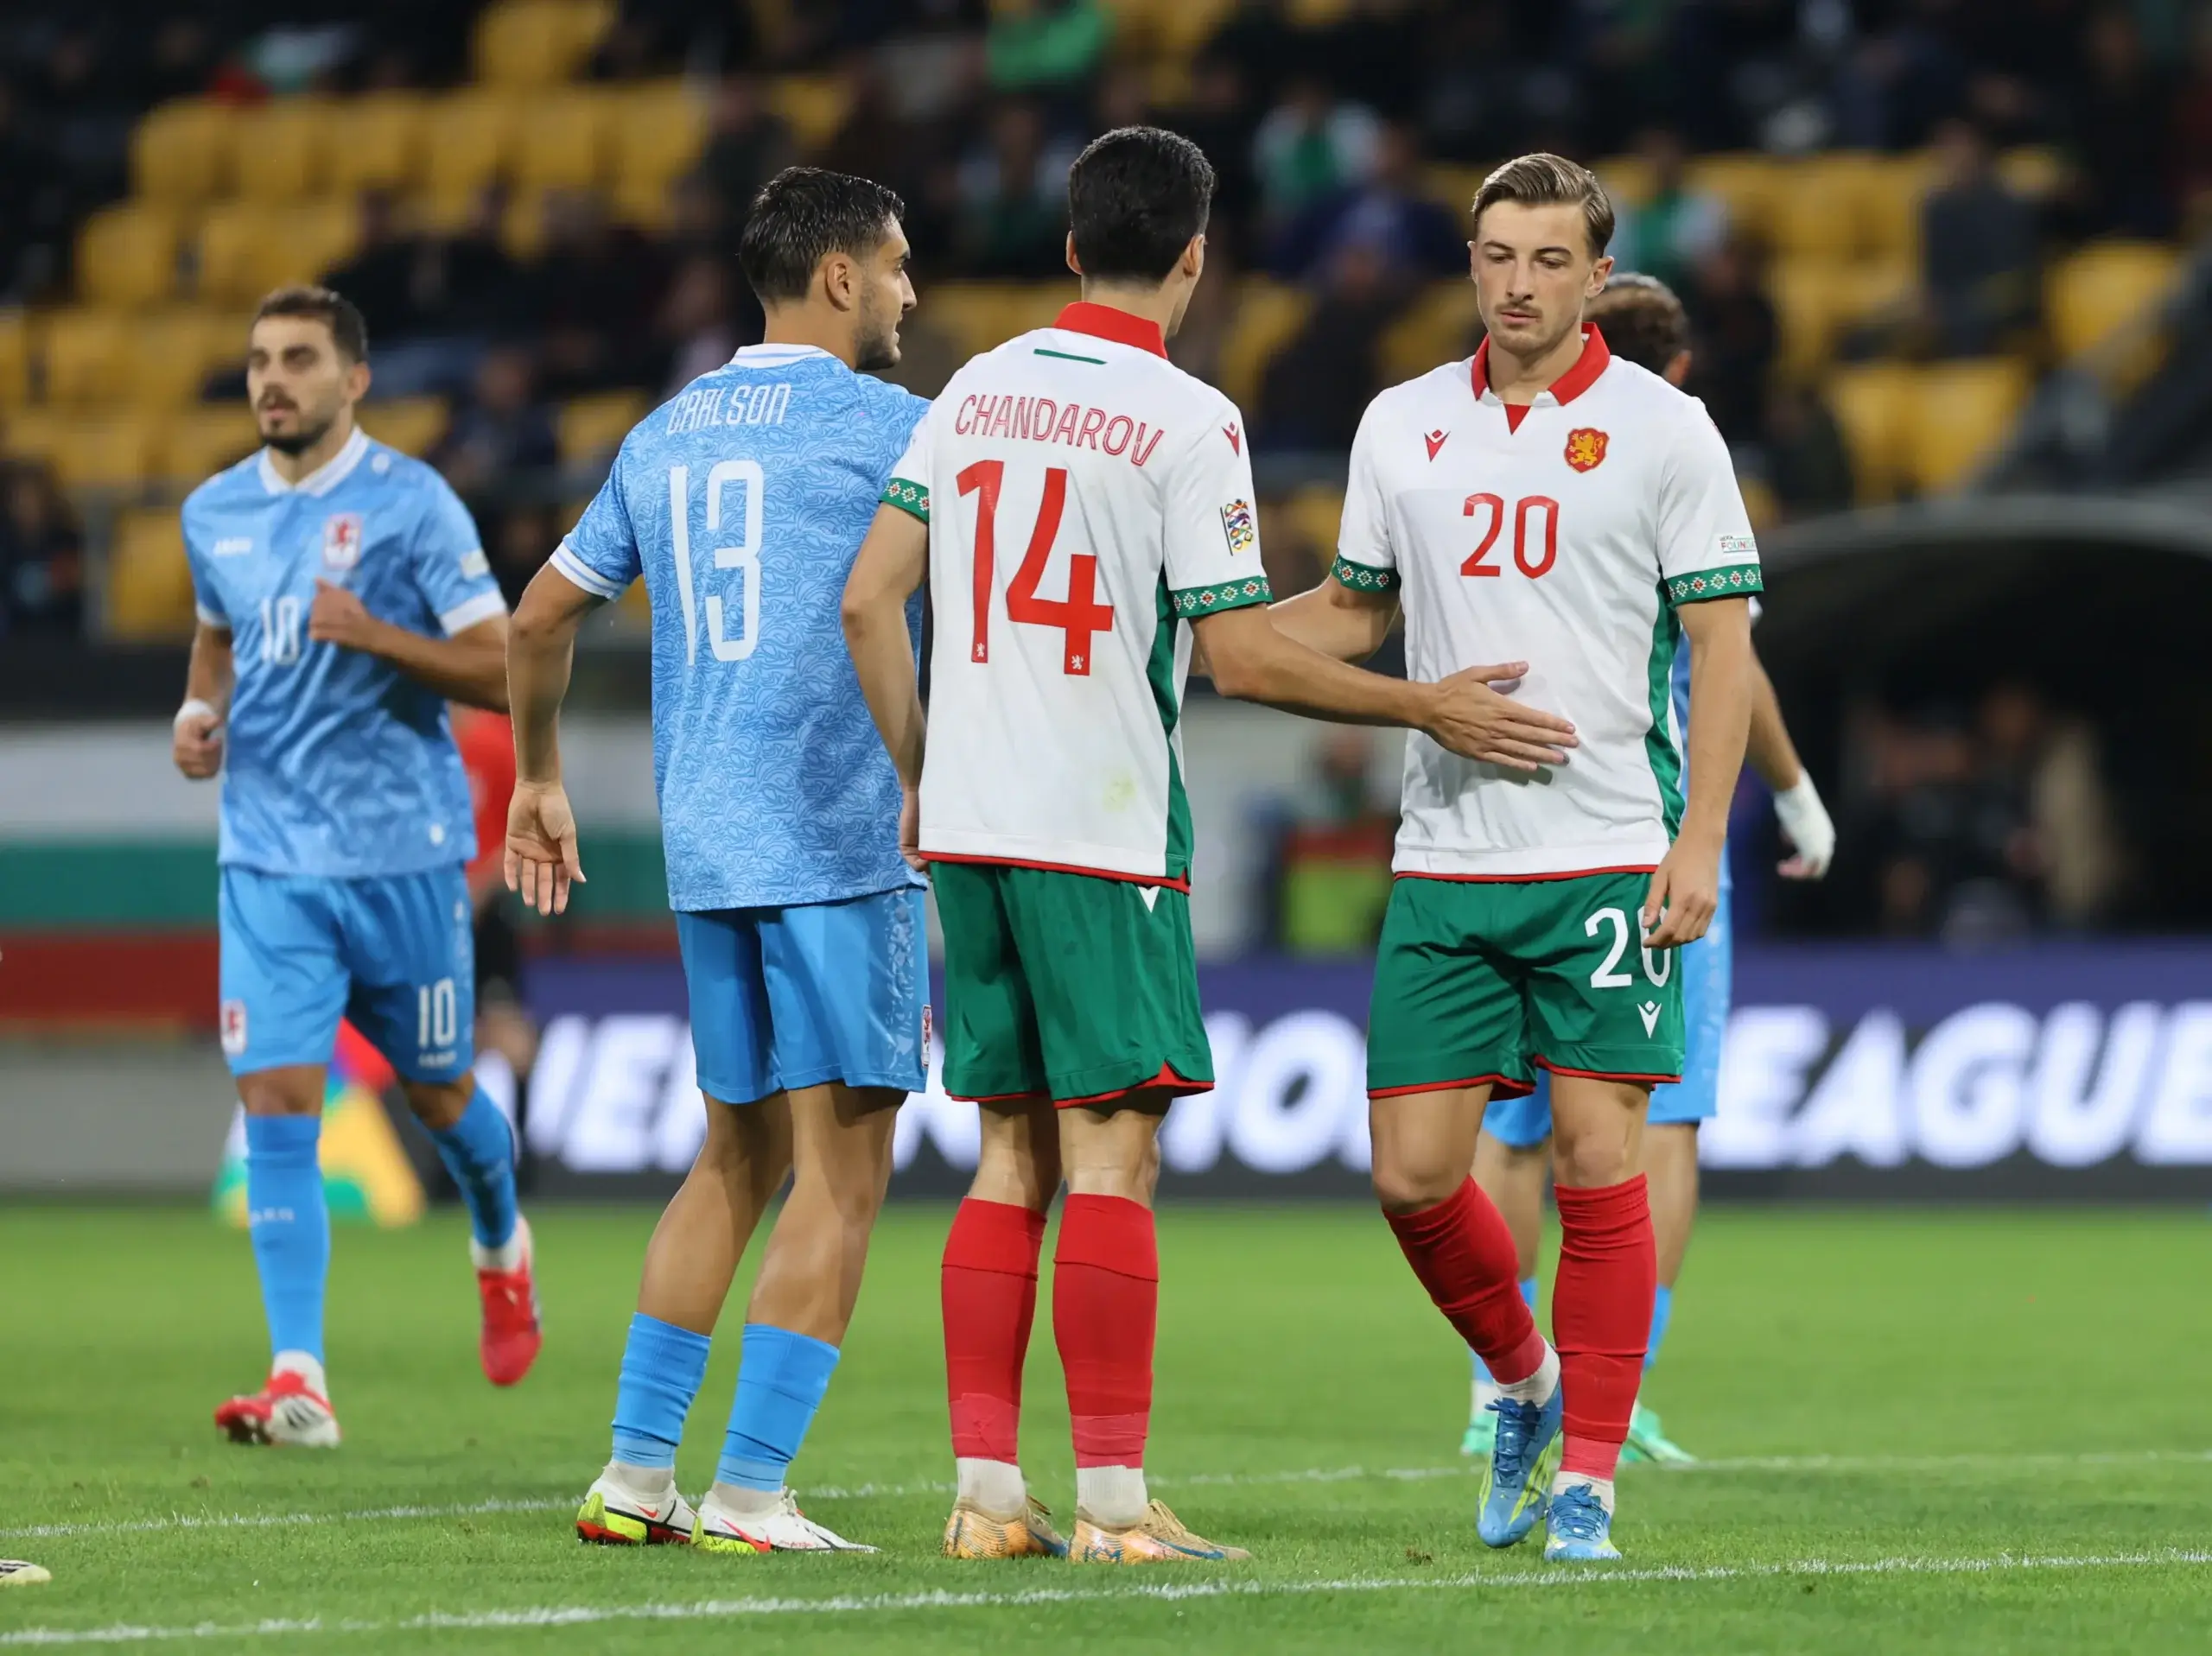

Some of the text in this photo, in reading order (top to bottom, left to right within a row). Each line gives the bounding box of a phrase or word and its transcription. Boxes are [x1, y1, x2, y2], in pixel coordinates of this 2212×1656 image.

[666, 384, 791, 435] CARLSON
[956, 394, 1164, 466] CHANDAROV
[670, 460, 764, 666] 13
[956, 459, 1114, 676] 14
[1460, 492, 1560, 579] 20
[261, 595, 301, 666] 10
[1585, 905, 1671, 988] 20
[418, 977, 456, 1049] 10
[1698, 998, 2212, 1168] EAGUE
